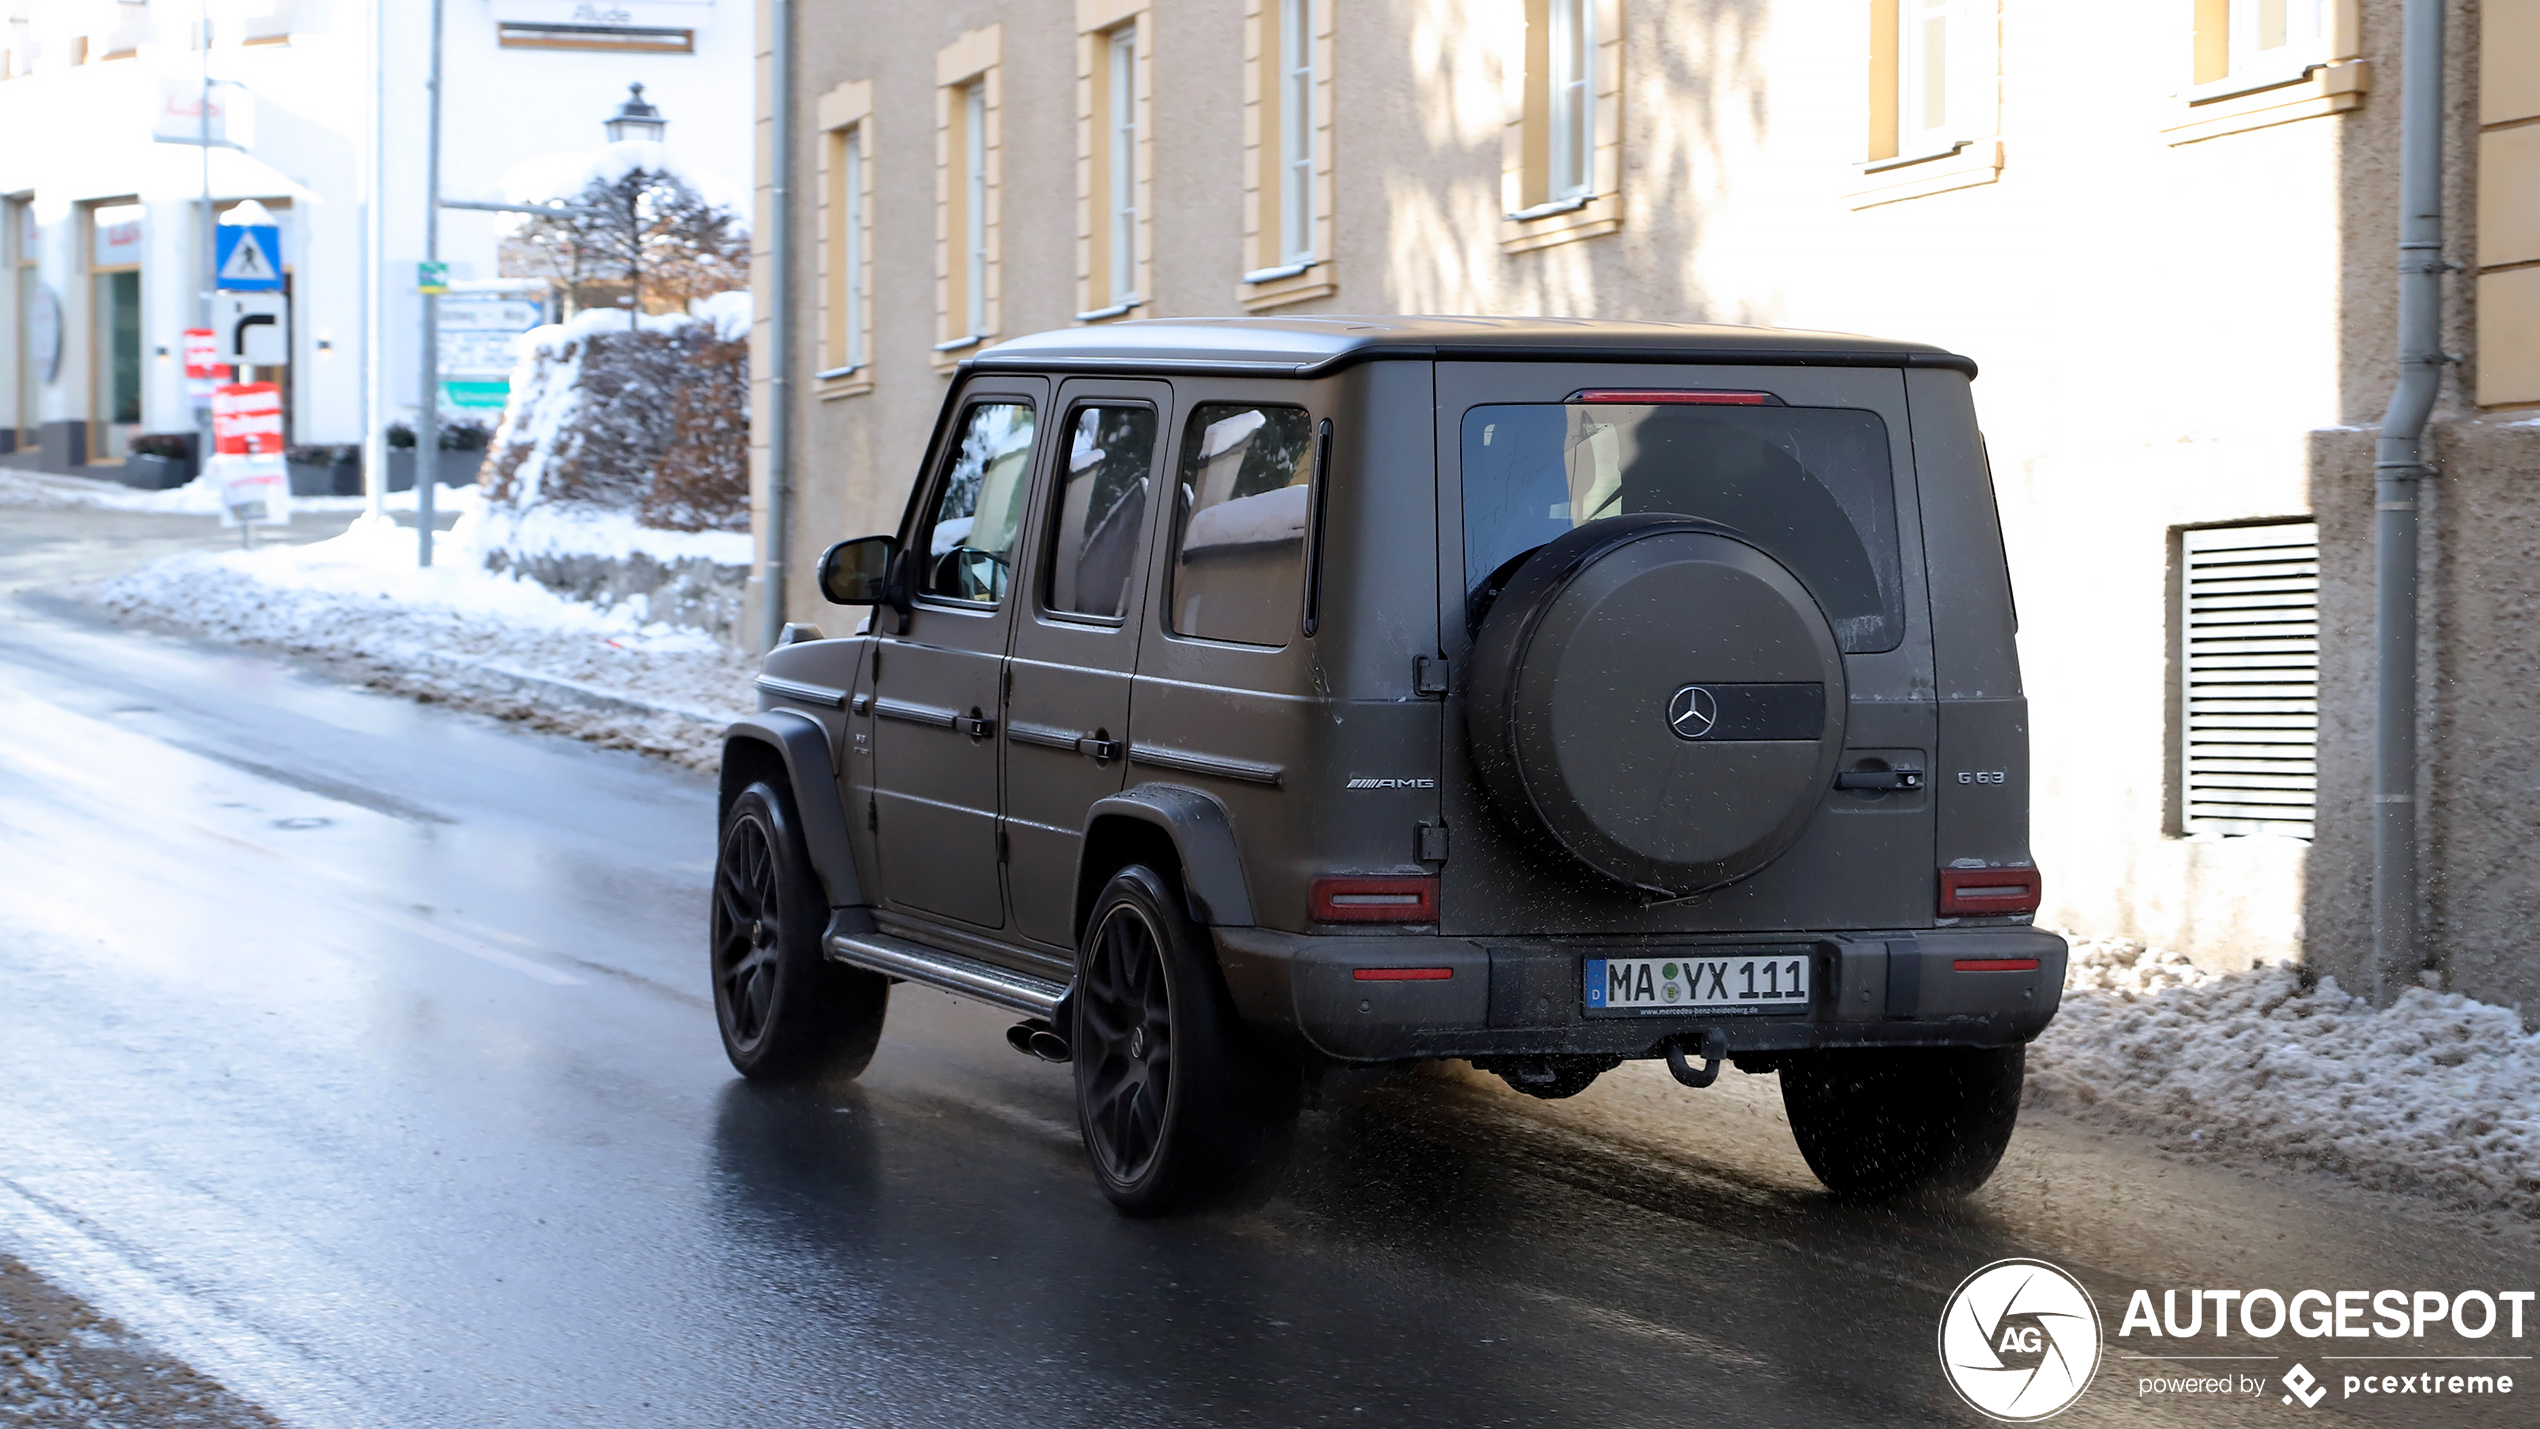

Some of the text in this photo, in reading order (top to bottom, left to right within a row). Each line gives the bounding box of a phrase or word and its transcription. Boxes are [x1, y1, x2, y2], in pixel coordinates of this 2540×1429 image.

[1957, 771, 2005, 784] G 63
[1375, 779, 1434, 789] AMG
[1608, 960, 1806, 1002] MA YX 111
[1591, 989, 1601, 1000] D
[1640, 1006, 1759, 1016] www.mercedes-benz-heidelberg.de
